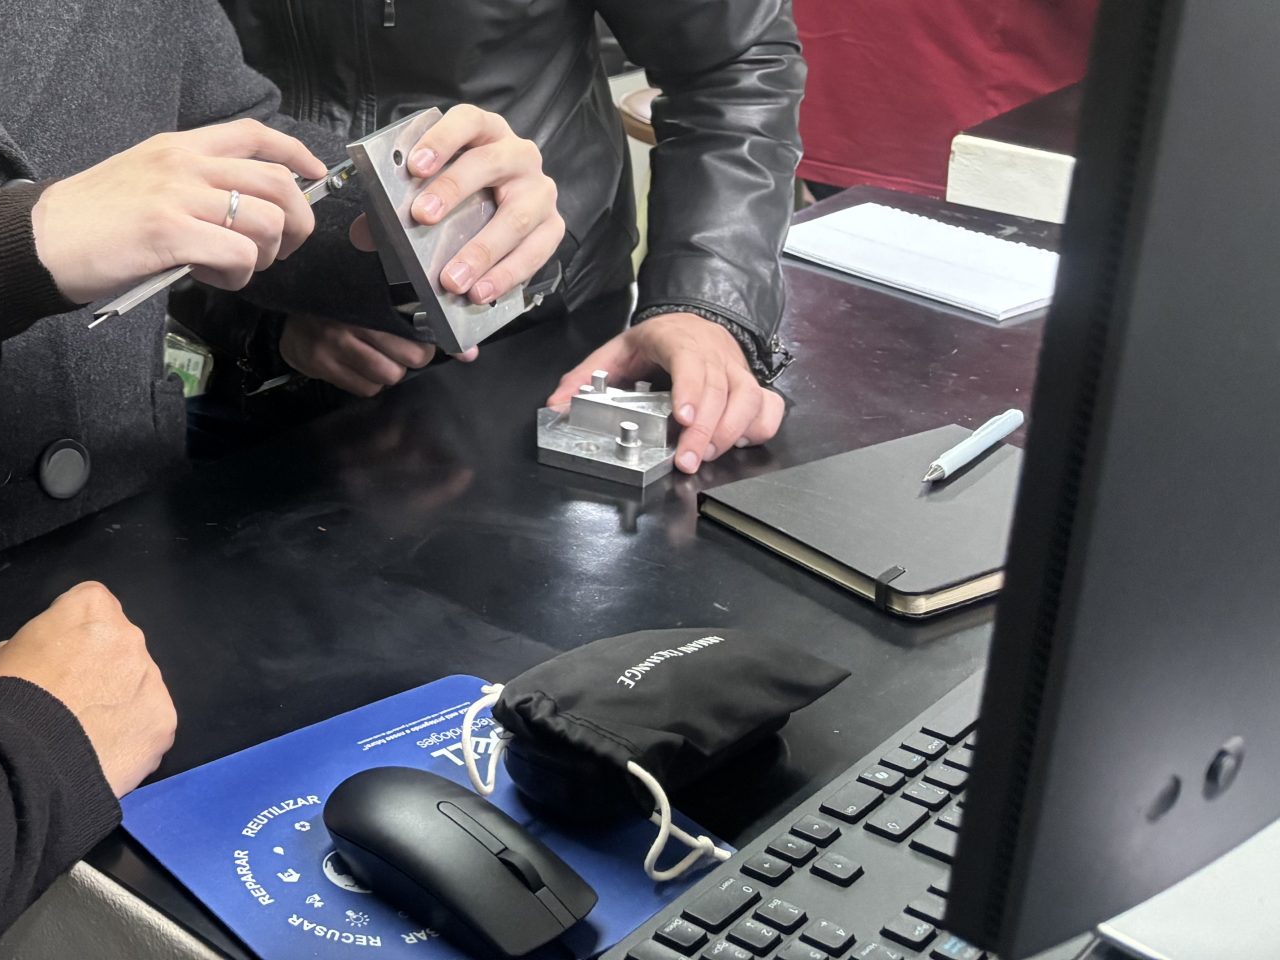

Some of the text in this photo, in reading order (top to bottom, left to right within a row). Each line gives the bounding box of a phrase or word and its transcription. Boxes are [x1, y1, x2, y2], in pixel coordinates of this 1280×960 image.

[617, 636, 725, 689] ARMANI EXCHANGE
[242, 795, 321, 837] REUTILIZAR
[234, 849, 275, 906] REPARAR
[768, 898, 781, 908] End
[288, 913, 382, 947] RECUSAR
[761, 928, 773, 937] 2
[836, 928, 846, 937] 4
[735, 951, 746, 959] 3
[809, 951, 821, 959] 5
